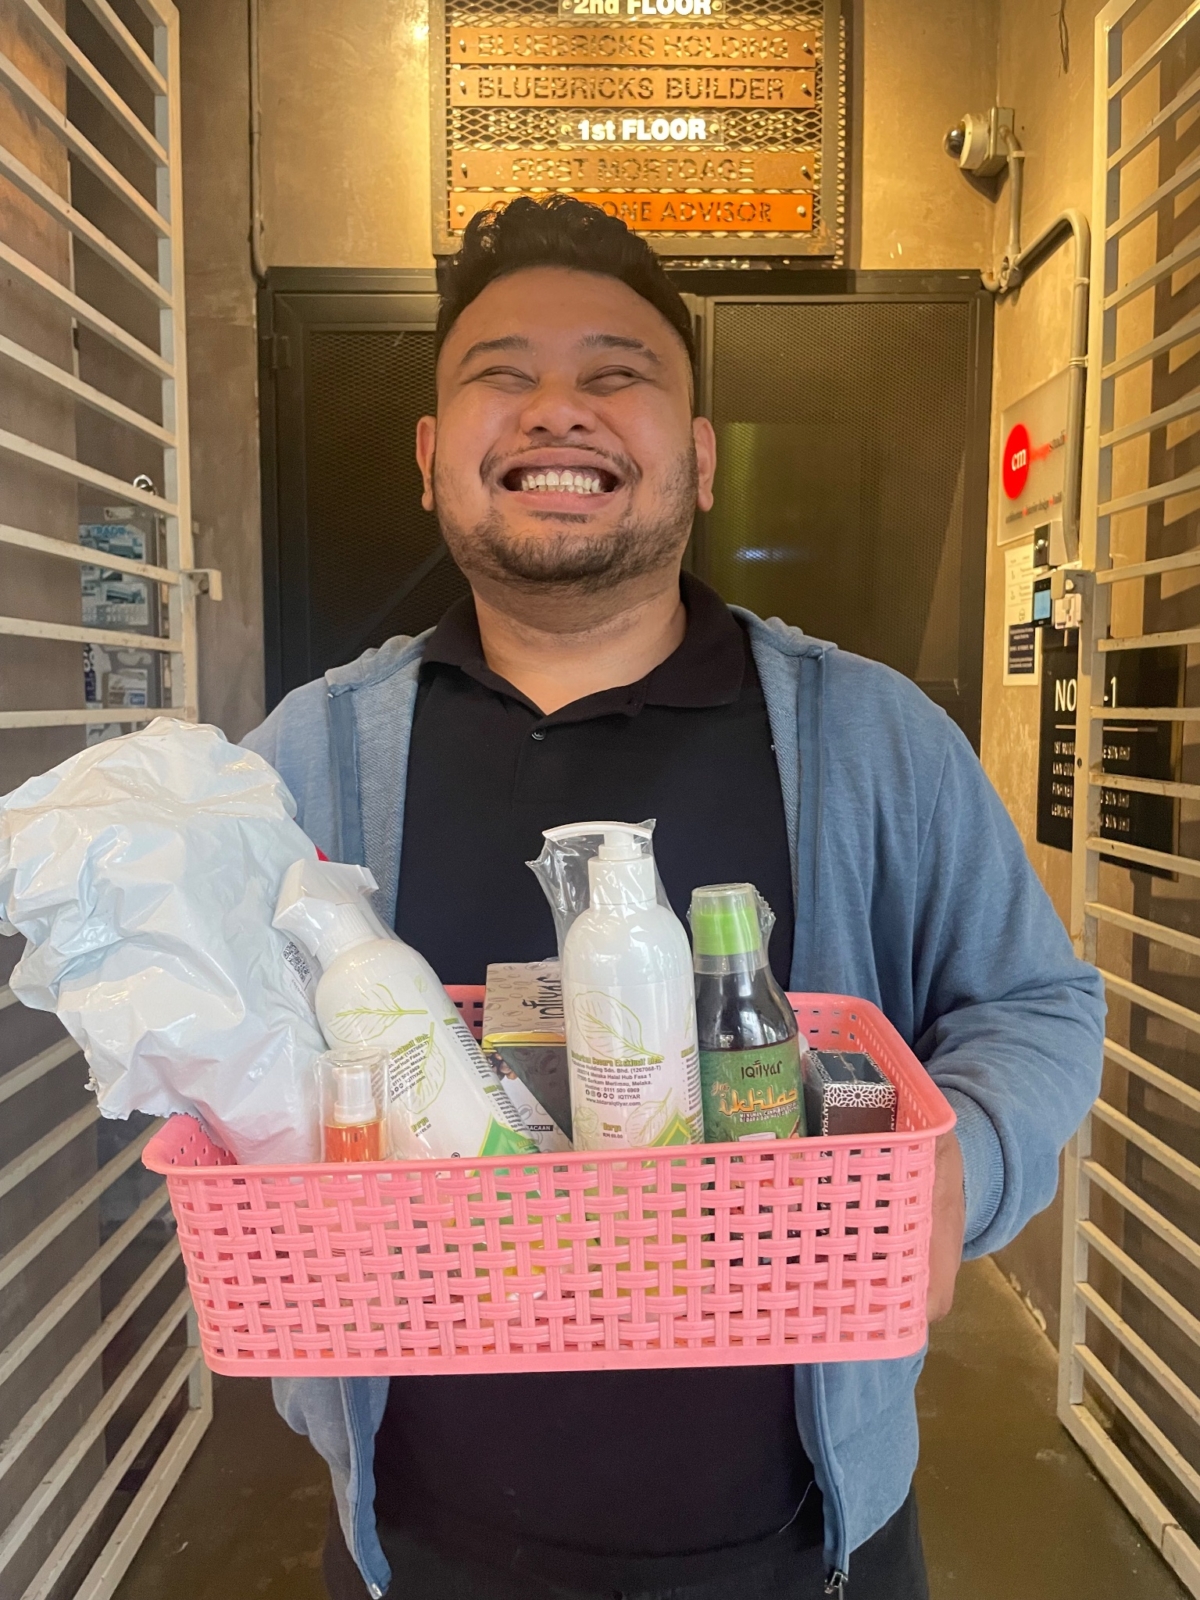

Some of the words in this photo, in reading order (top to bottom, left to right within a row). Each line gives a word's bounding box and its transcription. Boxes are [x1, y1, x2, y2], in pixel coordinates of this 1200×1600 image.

[573, 0, 619, 14] 2nd
[626, 0, 713, 15] FLOOR
[478, 34, 655, 58] BLUEBRICKS
[663, 35, 789, 60] HOLDING
[478, 76, 654, 100] BLUEBRICKS
[666, 77, 785, 100] BUILDER
[577, 118, 616, 140] 1st
[622, 118, 707, 141] FLOOR
[512, 157, 589, 182] FIRST
[598, 158, 755, 183] MORTGAGE
[660, 201, 772, 223] ADVISOR
[1011, 448, 1026, 471] cm
